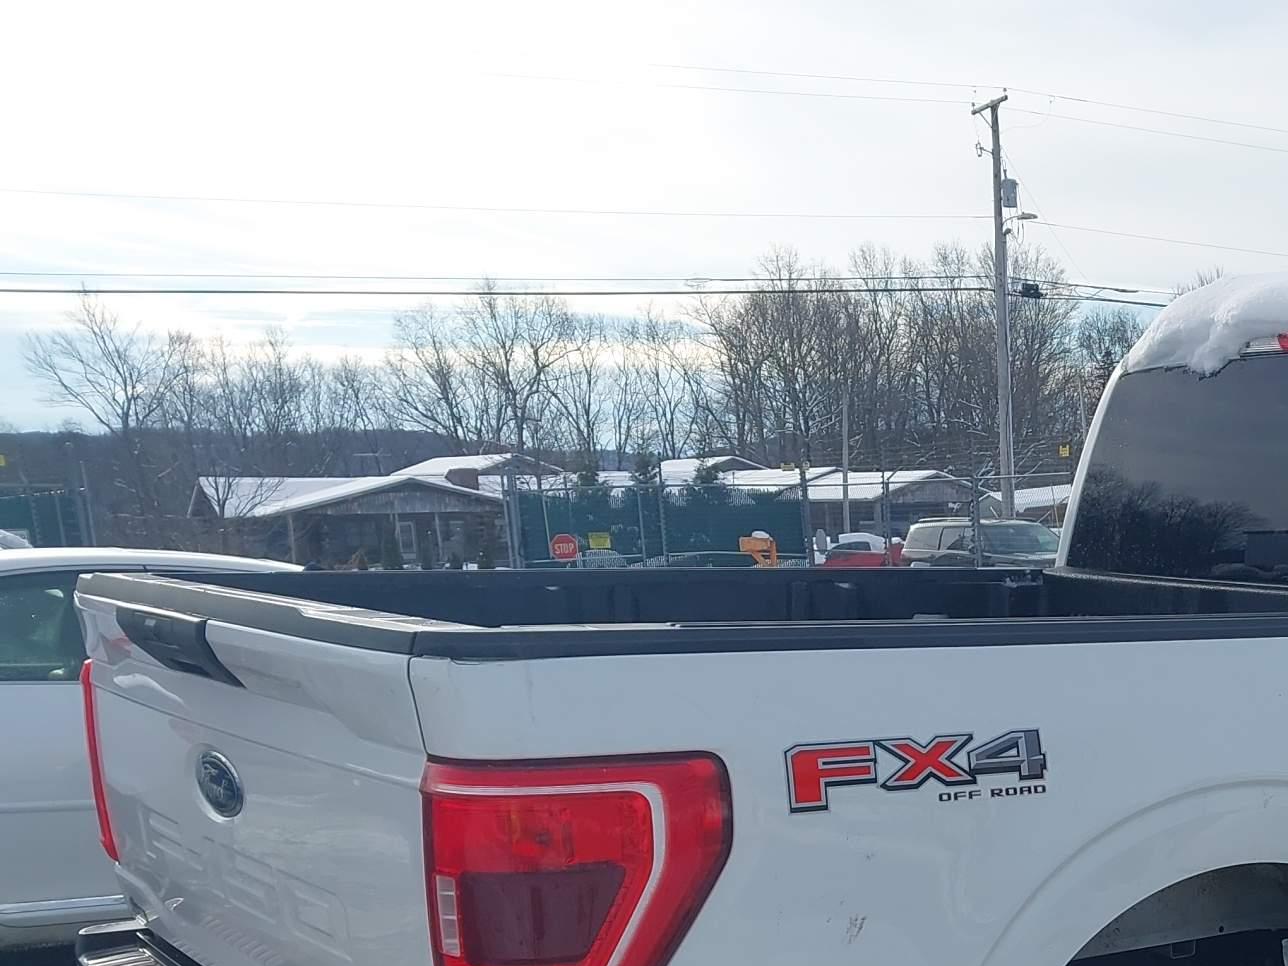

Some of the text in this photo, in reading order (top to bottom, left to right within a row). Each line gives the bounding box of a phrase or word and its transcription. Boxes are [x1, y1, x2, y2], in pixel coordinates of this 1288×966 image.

[554, 543, 574, 554] STOP
[784, 728, 1047, 813] FX4
[938, 784, 1047, 802] OFF ROAD
